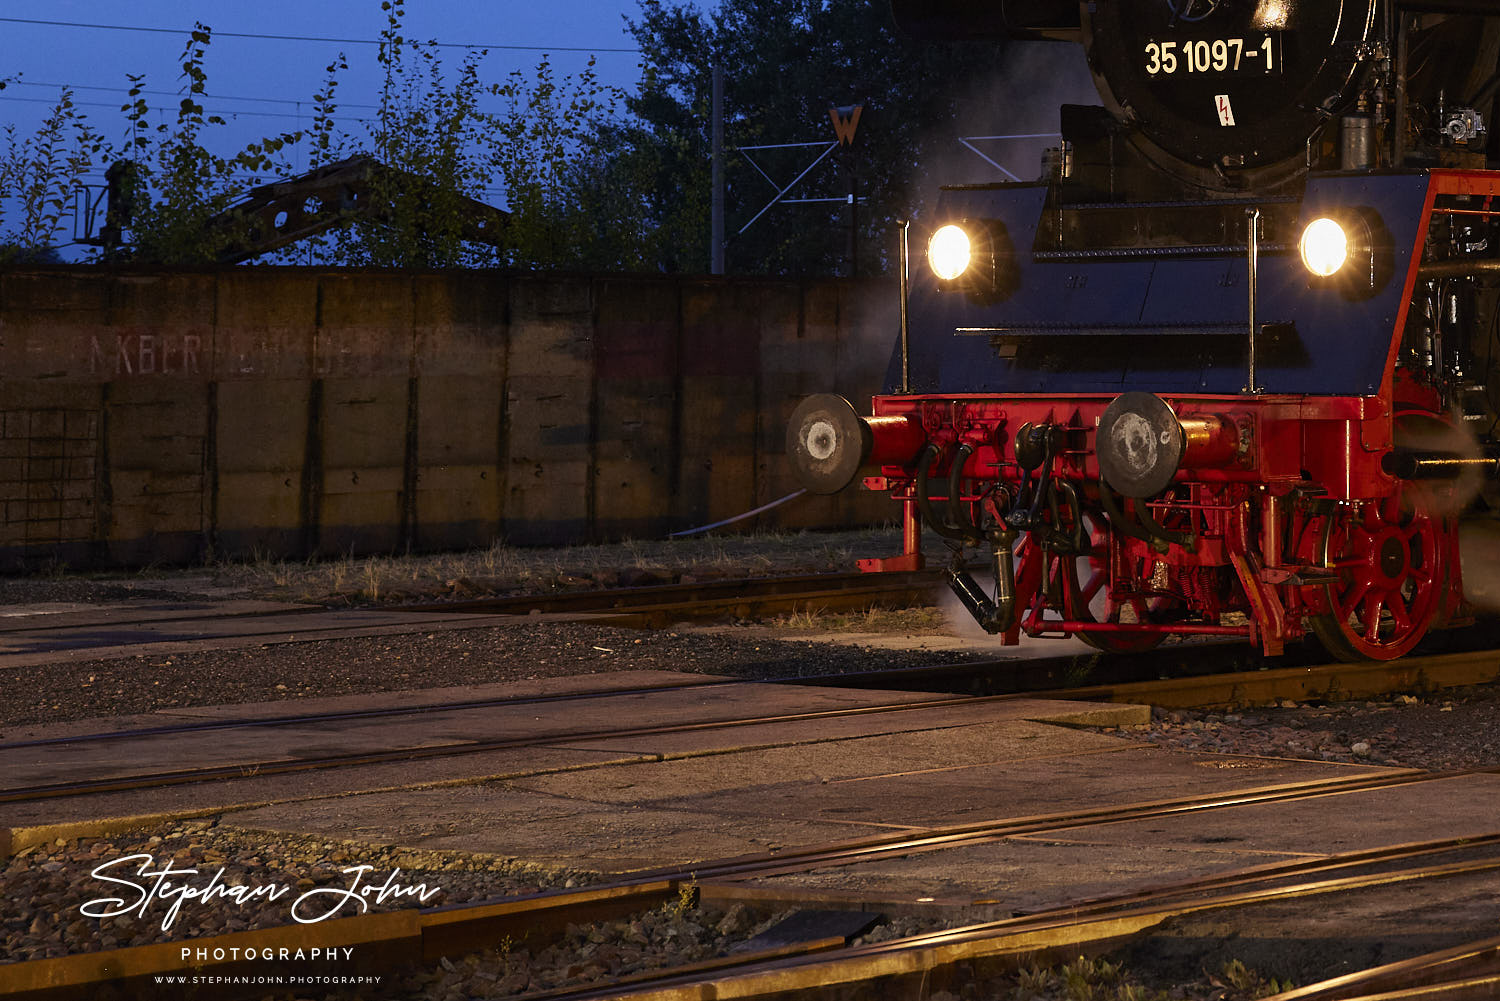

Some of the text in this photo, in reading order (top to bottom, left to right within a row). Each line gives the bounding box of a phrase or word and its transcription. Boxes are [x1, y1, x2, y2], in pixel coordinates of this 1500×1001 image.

[1145, 37, 1272, 74] 35 1097-1
[829, 105, 863, 146] W
